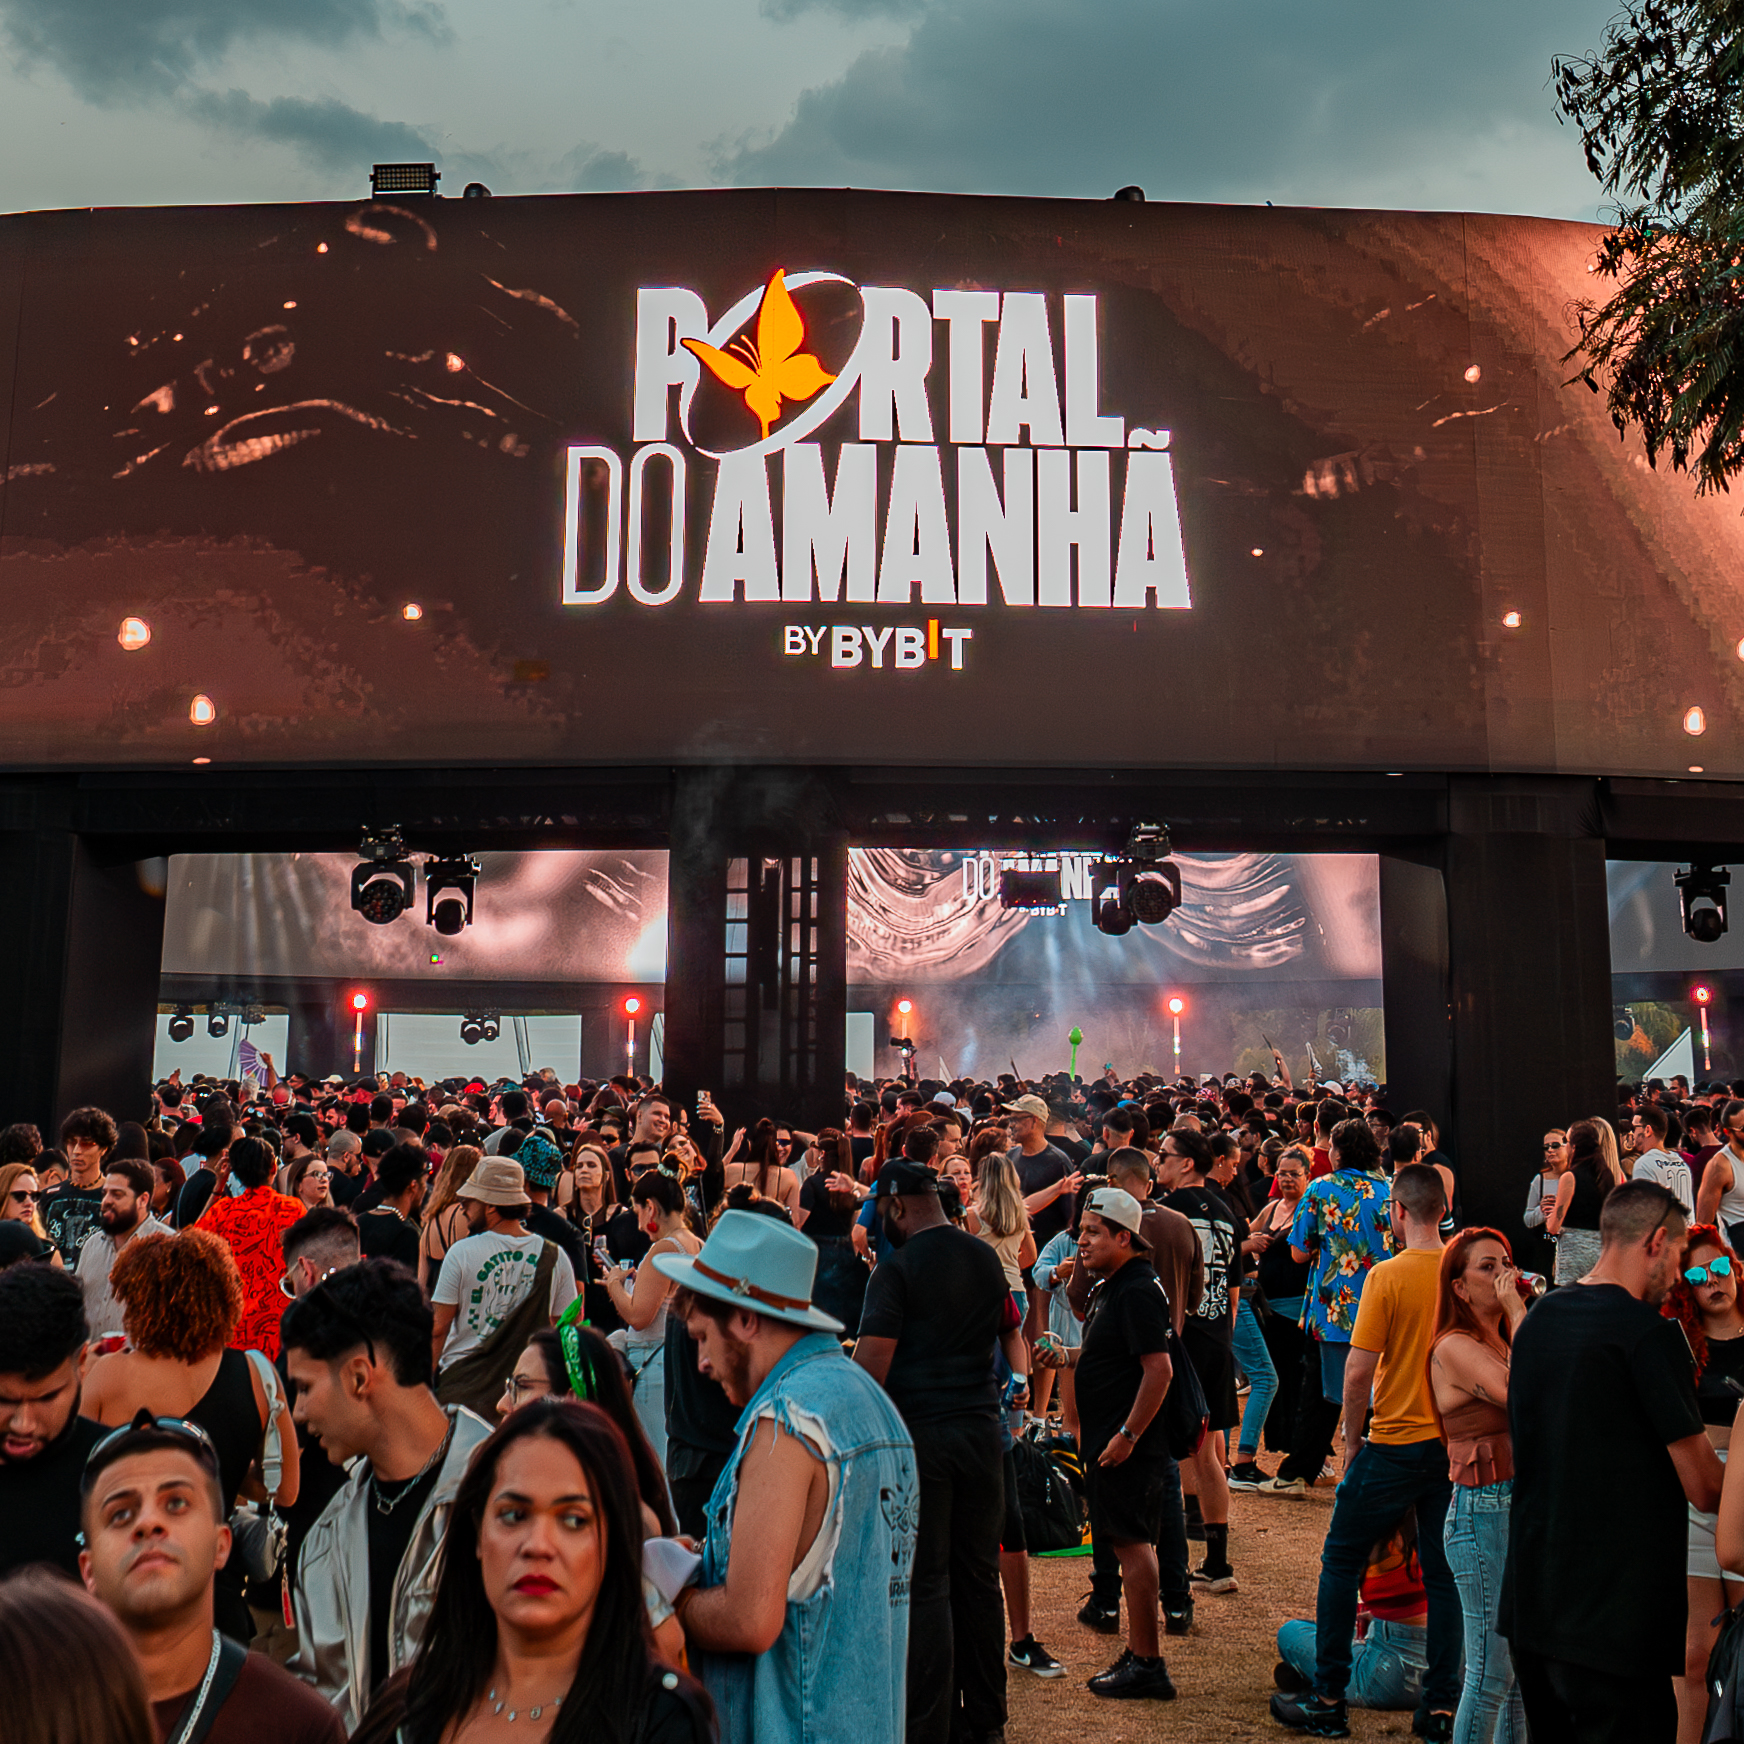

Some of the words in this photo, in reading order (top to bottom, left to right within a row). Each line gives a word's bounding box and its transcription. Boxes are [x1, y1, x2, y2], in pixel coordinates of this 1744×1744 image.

[633, 270, 1124, 459] PORTAL
[562, 443, 686, 605] DO
[699, 427, 1192, 609] AMANHÃ
[784, 625, 827, 655] BY
[831, 619, 973, 670] BYBIT
[962, 856, 995, 900] DO
[477, 1250, 524, 1282] GATITO
